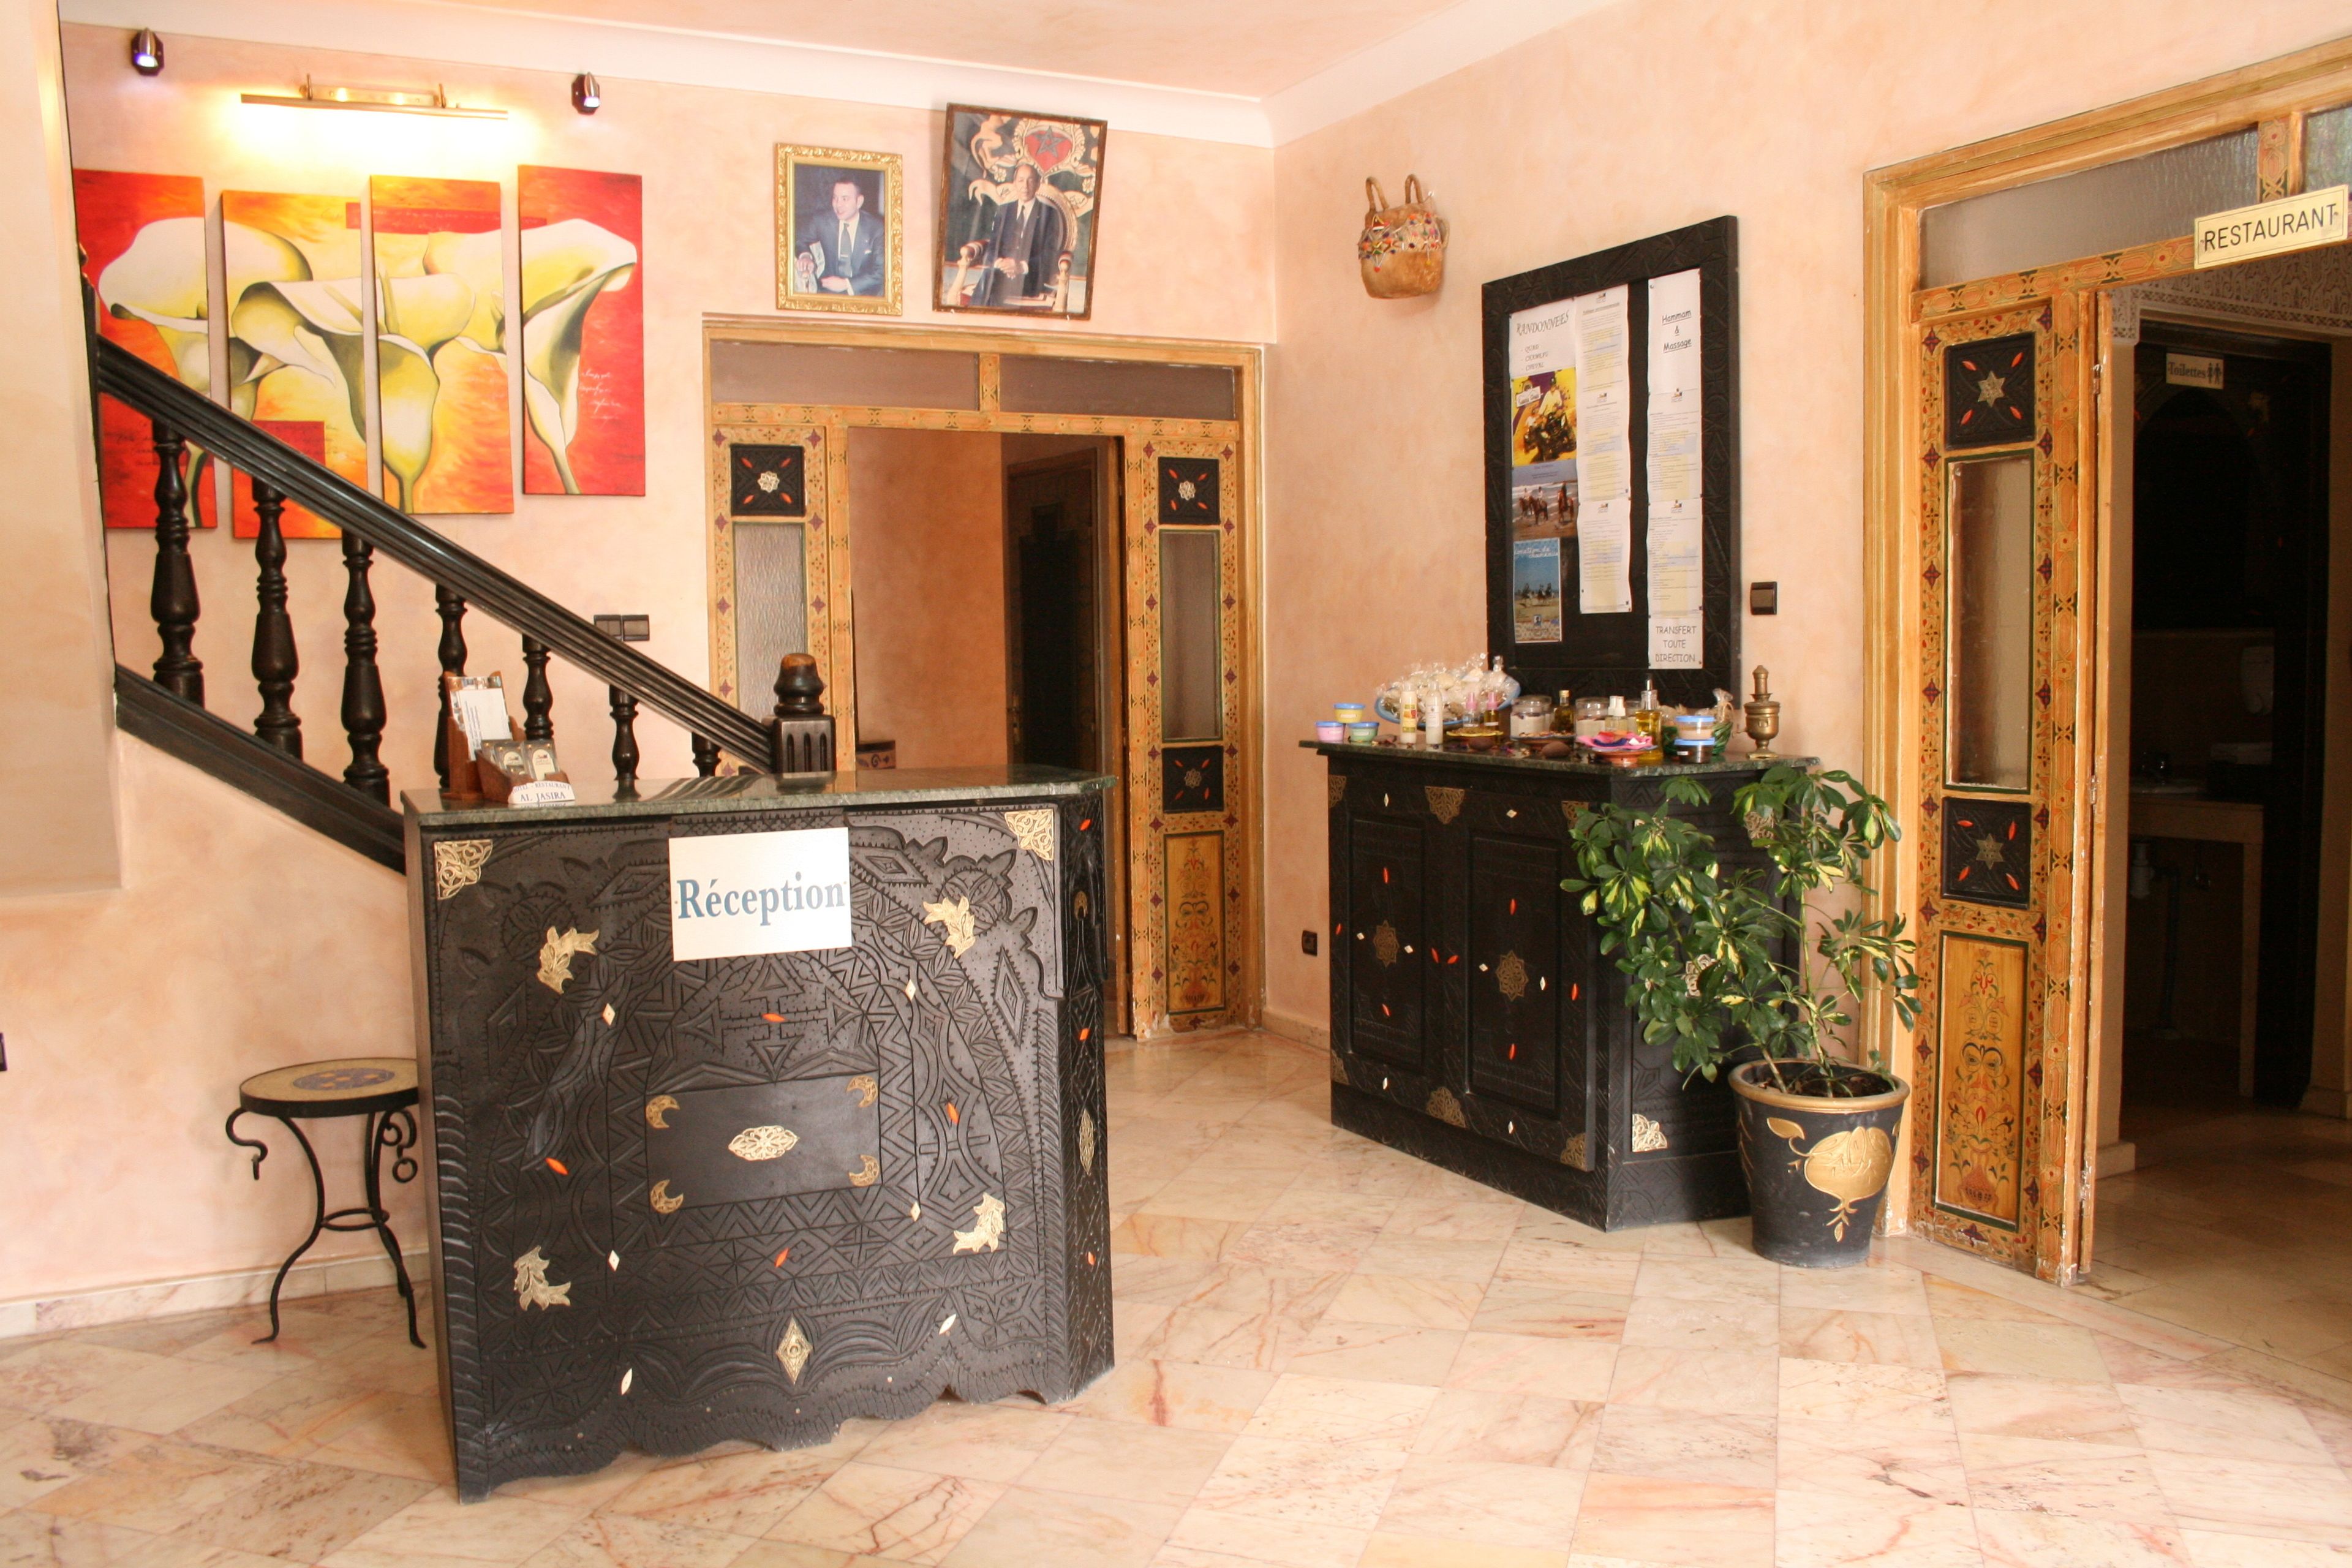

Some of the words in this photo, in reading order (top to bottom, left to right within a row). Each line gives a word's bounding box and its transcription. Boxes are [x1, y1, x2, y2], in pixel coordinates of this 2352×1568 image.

[2204, 203, 2337, 252] RESTAURANT
[1516, 309, 1569, 336] RANDONNEES
[1662, 310, 1692, 324] Hammam
[1675, 325, 1679, 334] &
[1663, 339, 1692, 351] Massage
[2168, 361, 2206, 379] Toilettes
[1656, 626, 1697, 635] TRANSFERT
[1655, 654, 1695, 662] DIRECTION
[521, 793, 533, 802] AL
[536, 791, 566, 802] JASIRA
[676, 871, 845, 926] Réception
